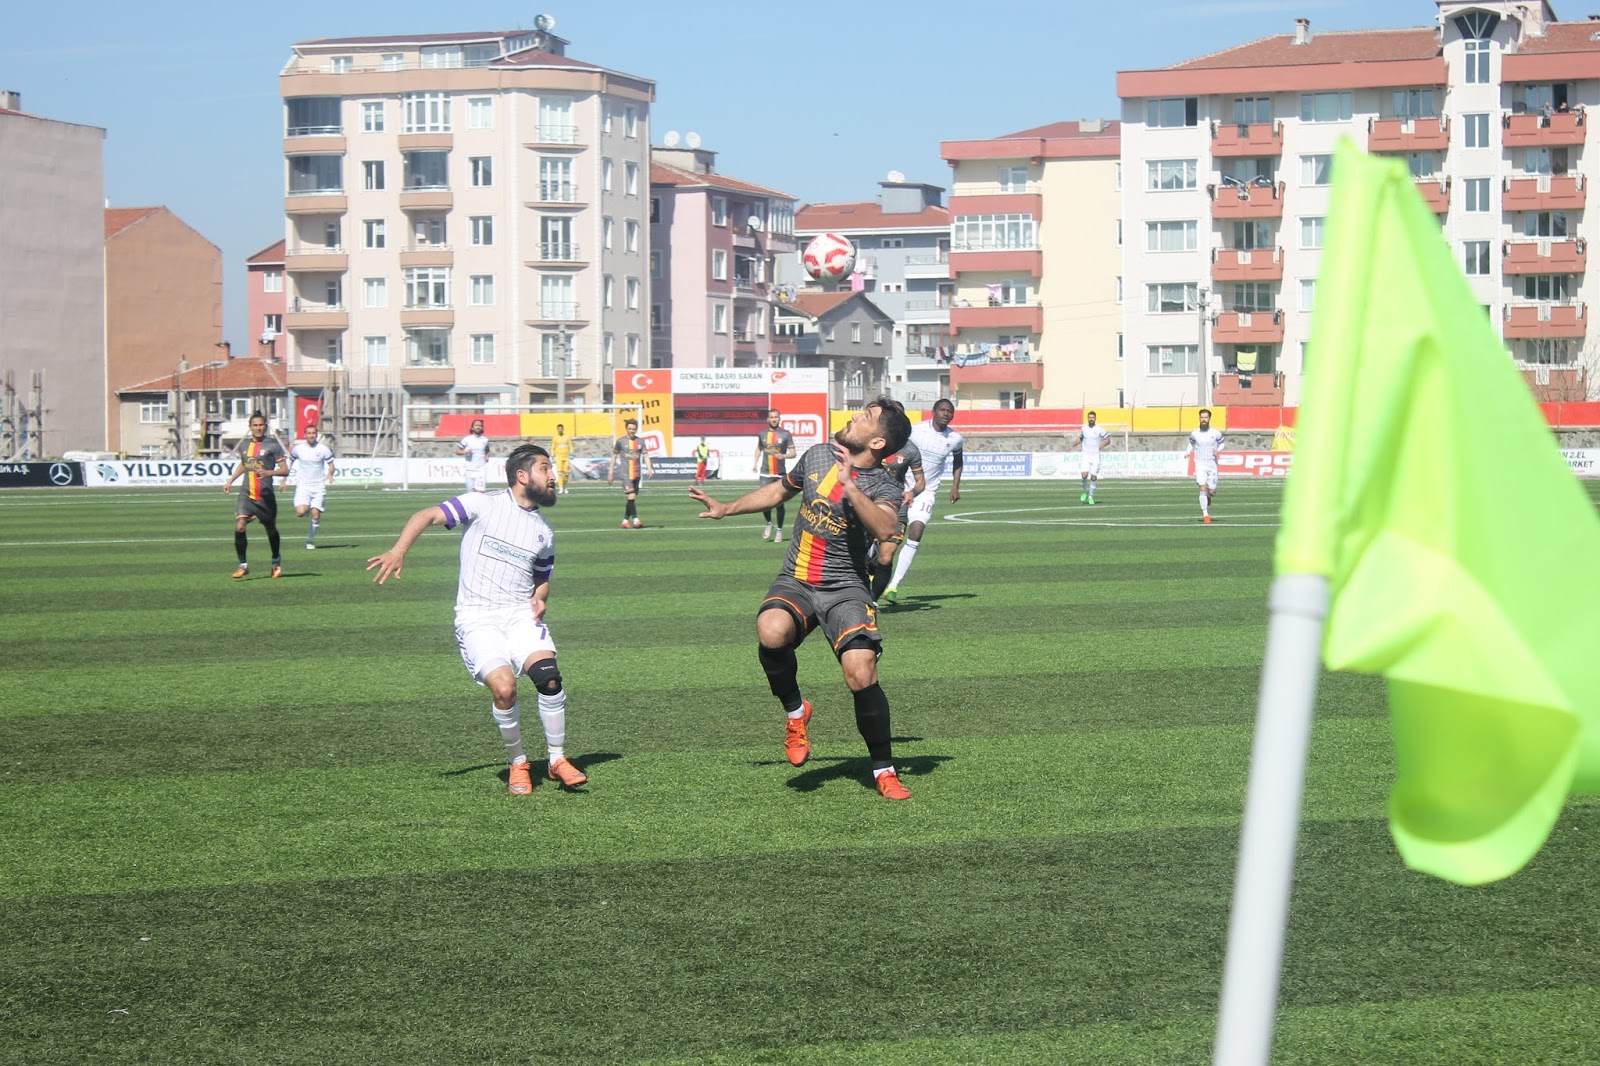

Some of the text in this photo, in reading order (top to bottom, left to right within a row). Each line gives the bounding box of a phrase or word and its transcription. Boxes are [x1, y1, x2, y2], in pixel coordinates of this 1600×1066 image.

[715, 371, 737, 380] BASRİ
[980, 464, 1025, 472] OKULLARI
[1564, 460, 1594, 468] ARKET
[123, 462, 235, 477] YILDIZSOY
